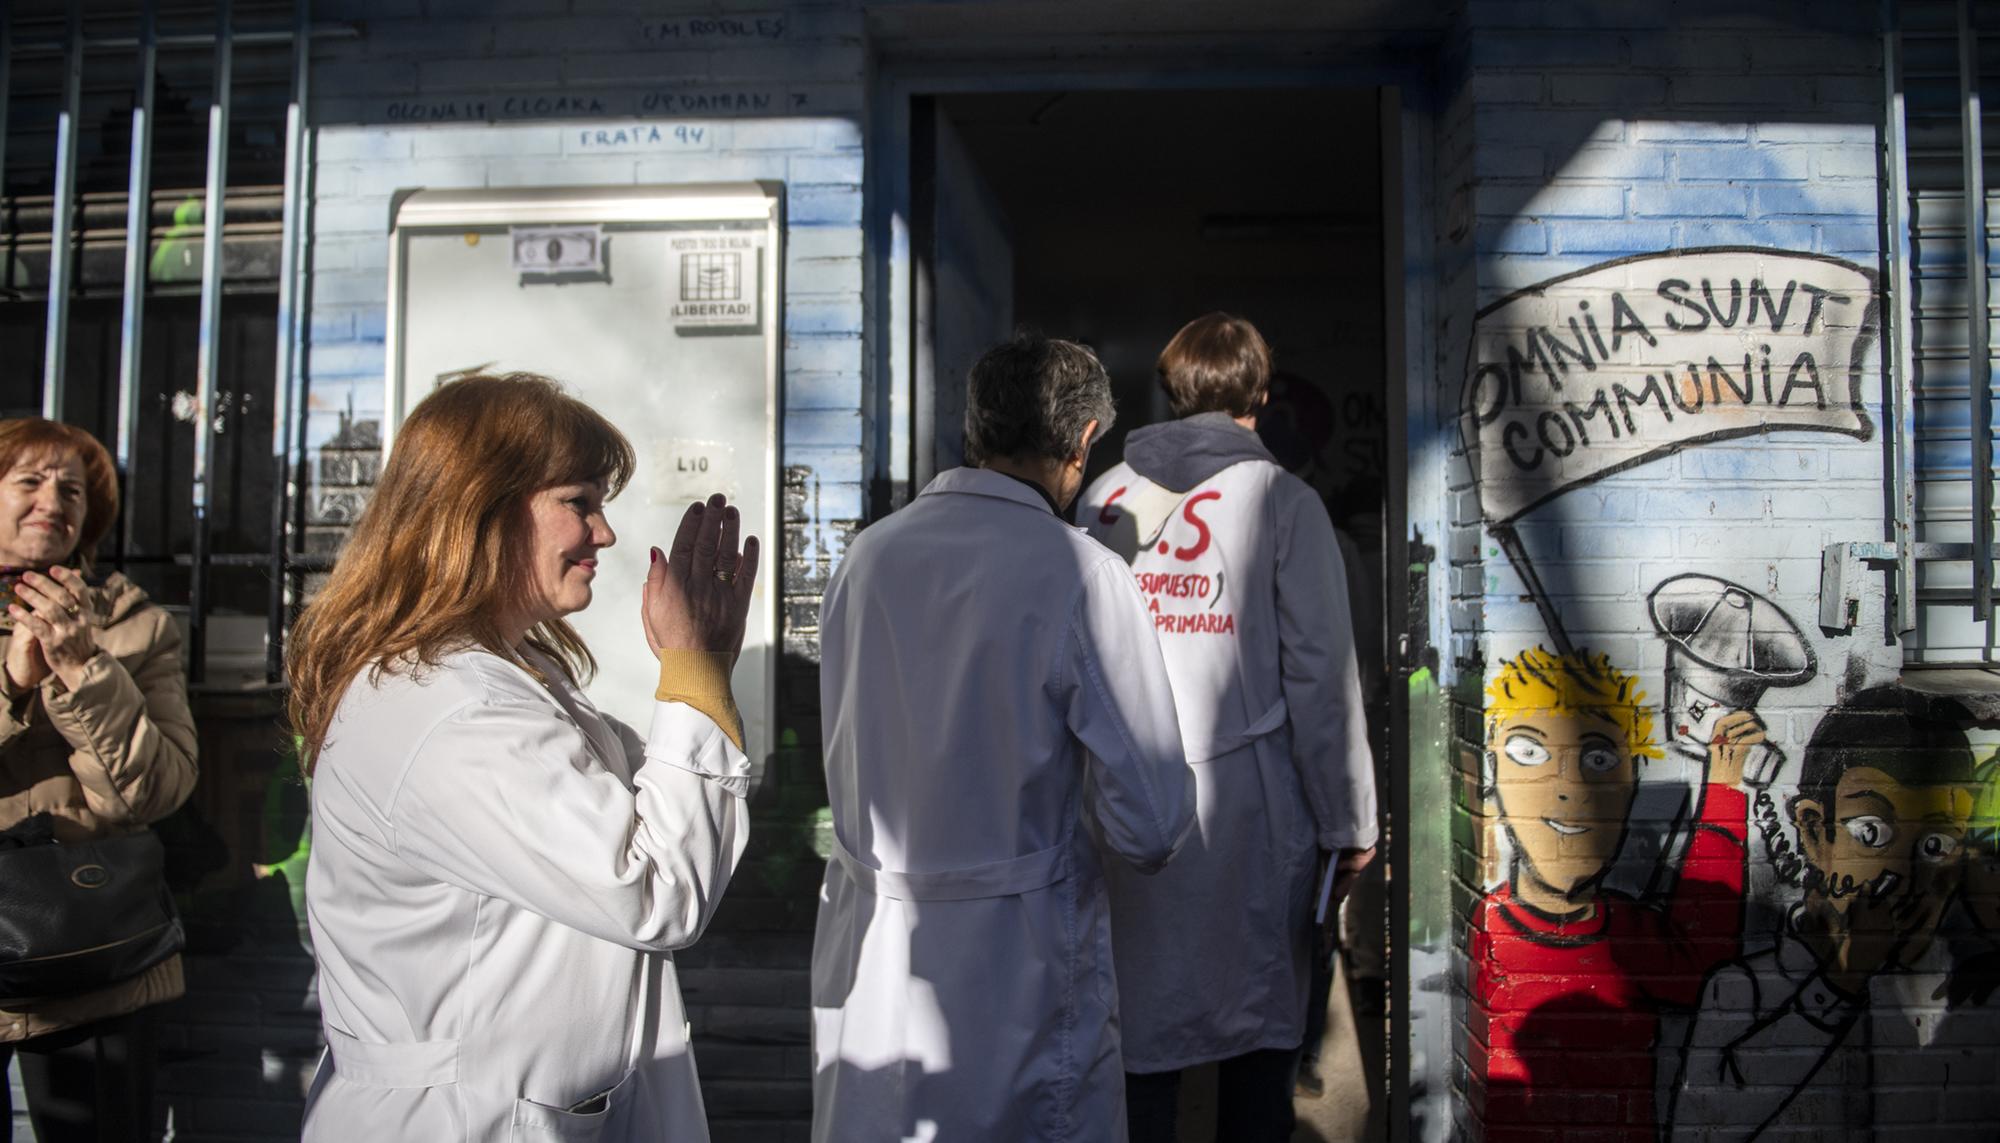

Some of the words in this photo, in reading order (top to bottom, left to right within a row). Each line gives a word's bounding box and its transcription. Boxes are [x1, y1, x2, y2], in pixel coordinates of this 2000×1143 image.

[503, 97, 605, 115] CLOAKA
[671, 303, 751, 317] ¡LIBERTAD!
[1656, 278, 1851, 337] SUNT
[1155, 613, 1234, 635] PRIMARIA
